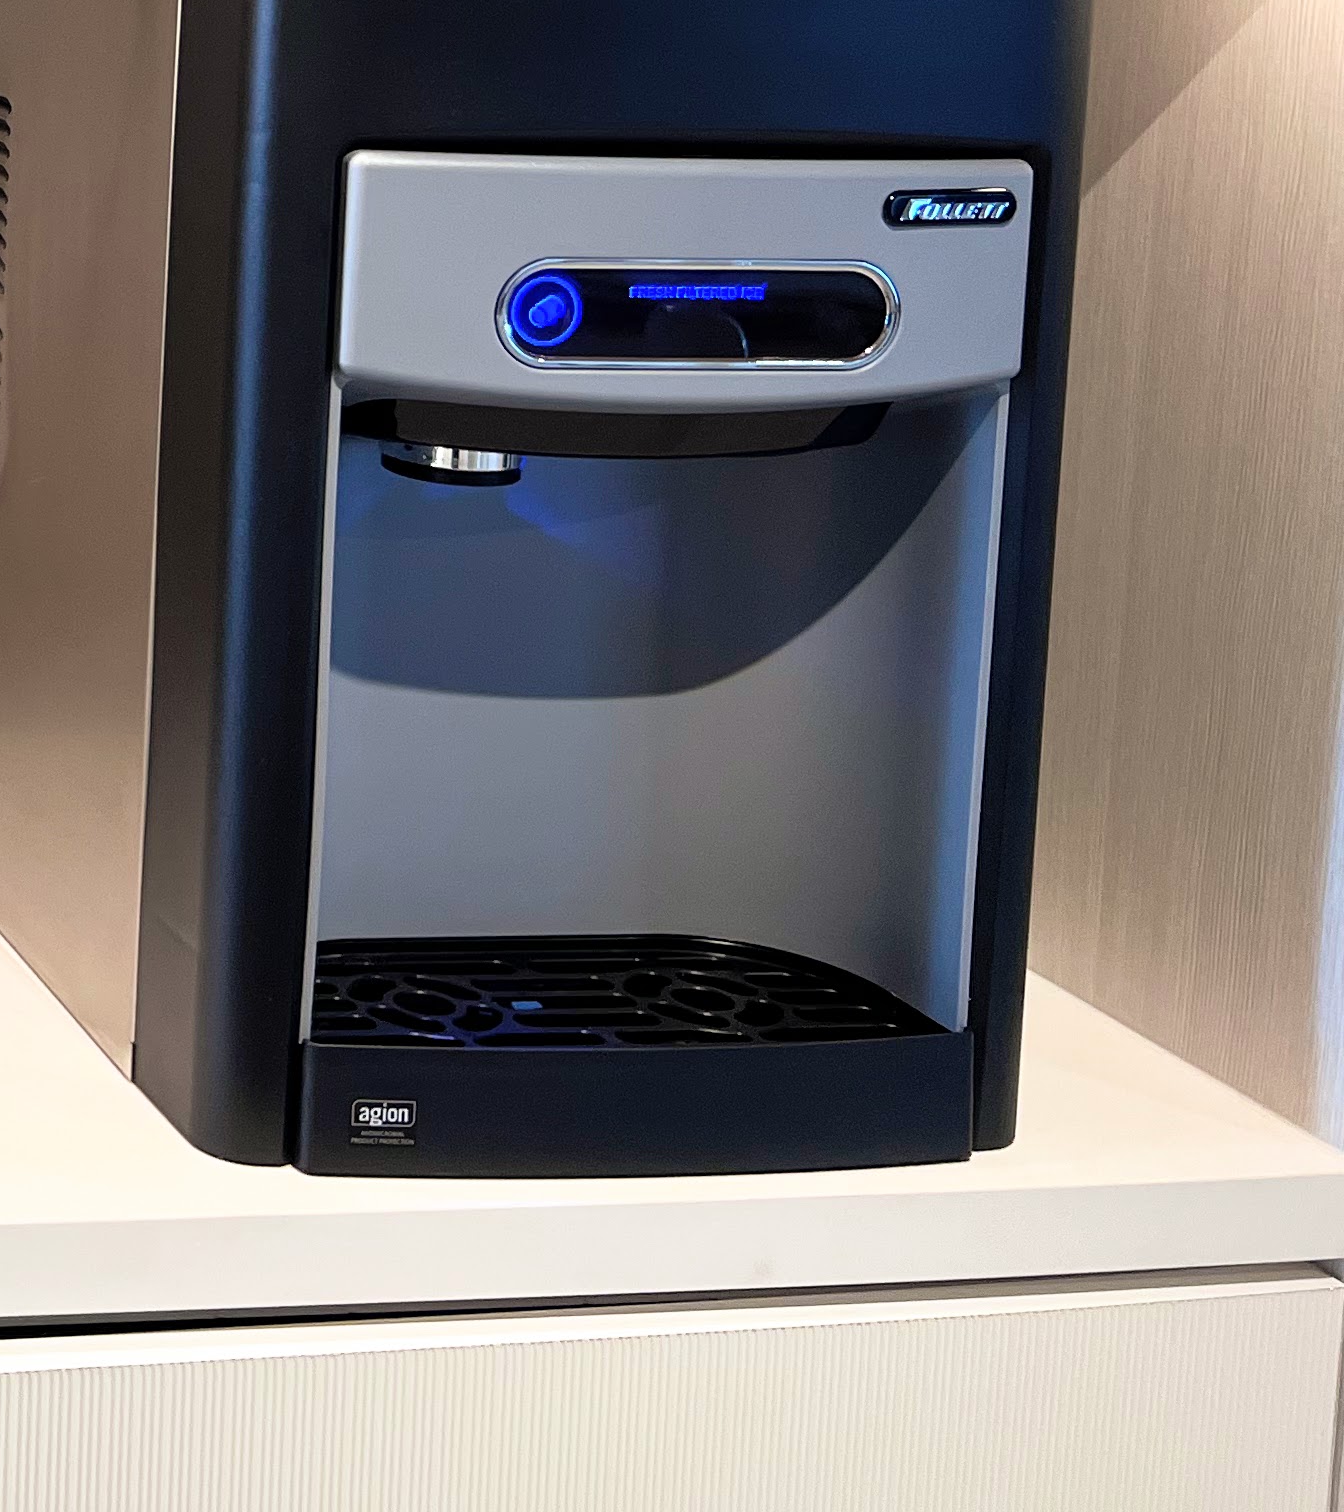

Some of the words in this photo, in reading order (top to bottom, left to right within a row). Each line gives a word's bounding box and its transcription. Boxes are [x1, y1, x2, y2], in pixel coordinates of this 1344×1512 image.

[628, 285, 674, 300] FRESH
[740, 285, 765, 300] ICE
[358, 1102, 410, 1127] agion
